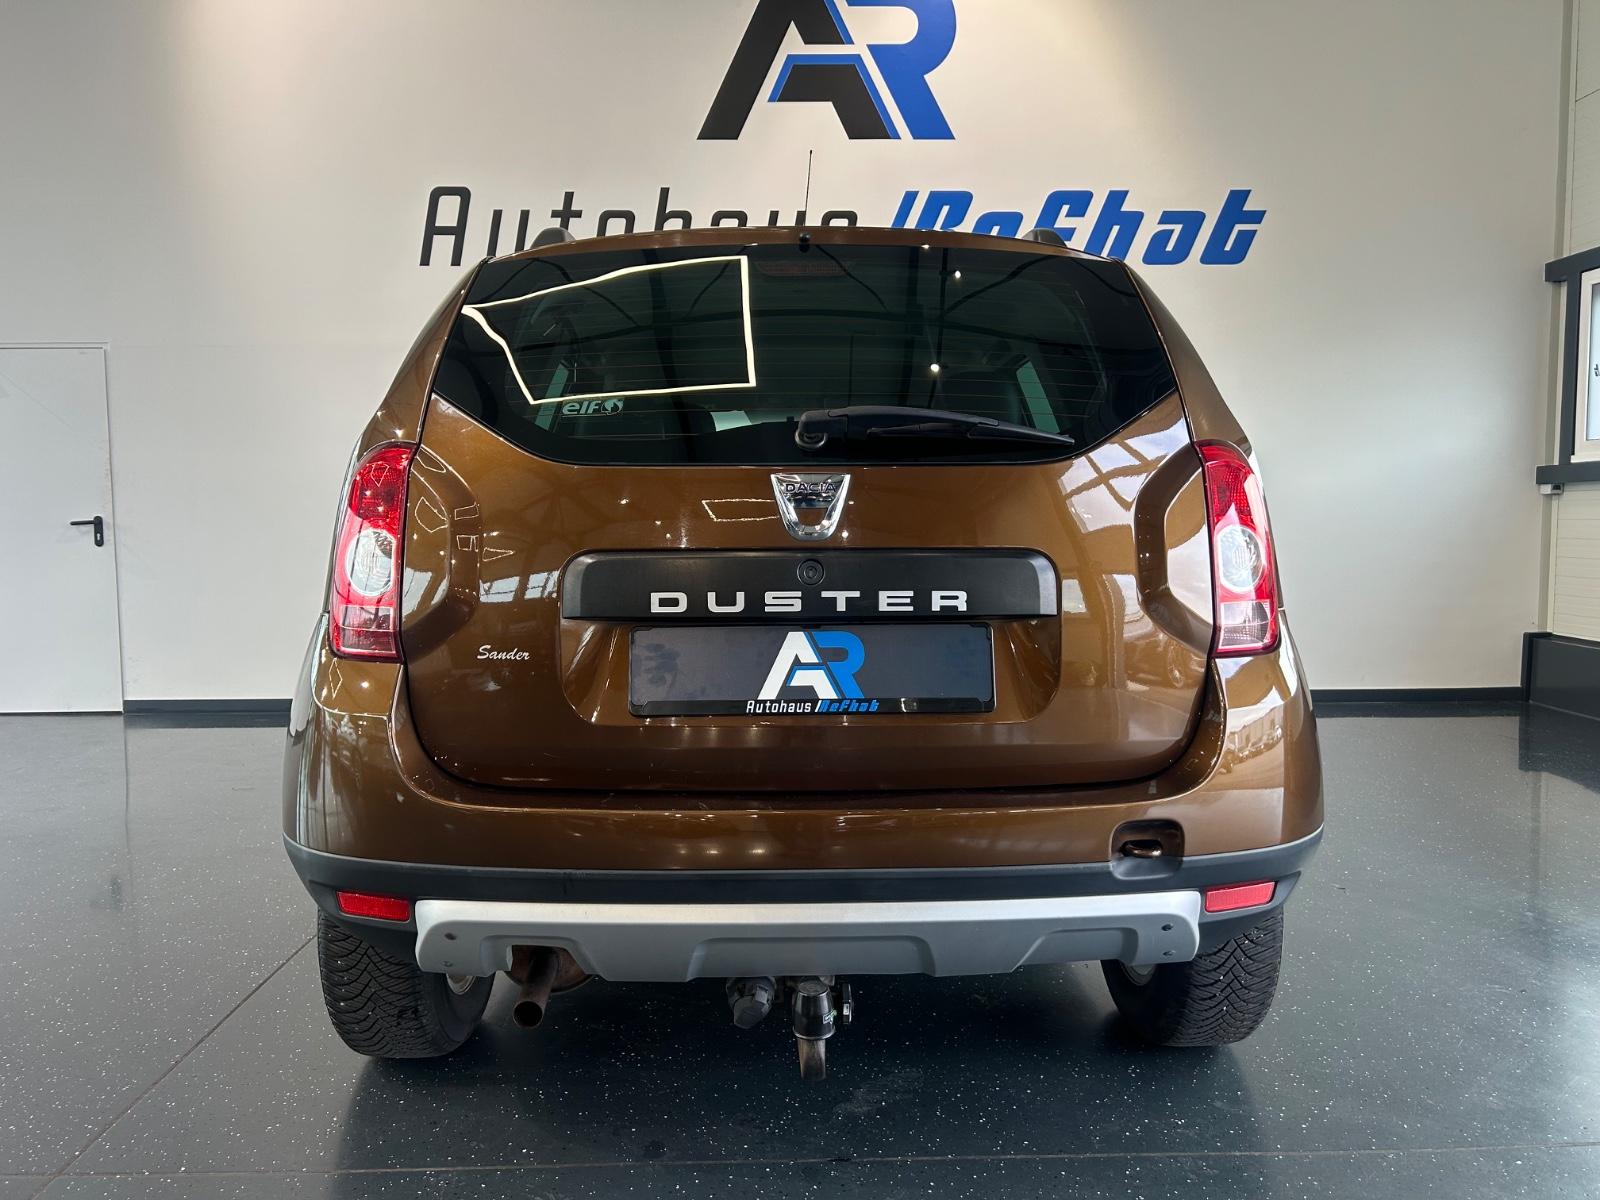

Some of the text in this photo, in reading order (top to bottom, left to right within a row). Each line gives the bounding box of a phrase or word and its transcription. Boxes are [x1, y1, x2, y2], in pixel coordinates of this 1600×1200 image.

[562, 400, 601, 415] elf
[785, 483, 836, 493] DACIA
[650, 590, 968, 613] DUSTER
[477, 644, 530, 660] Sander
[757, 631, 866, 700] AR
[746, 700, 811, 713] Autohaus
